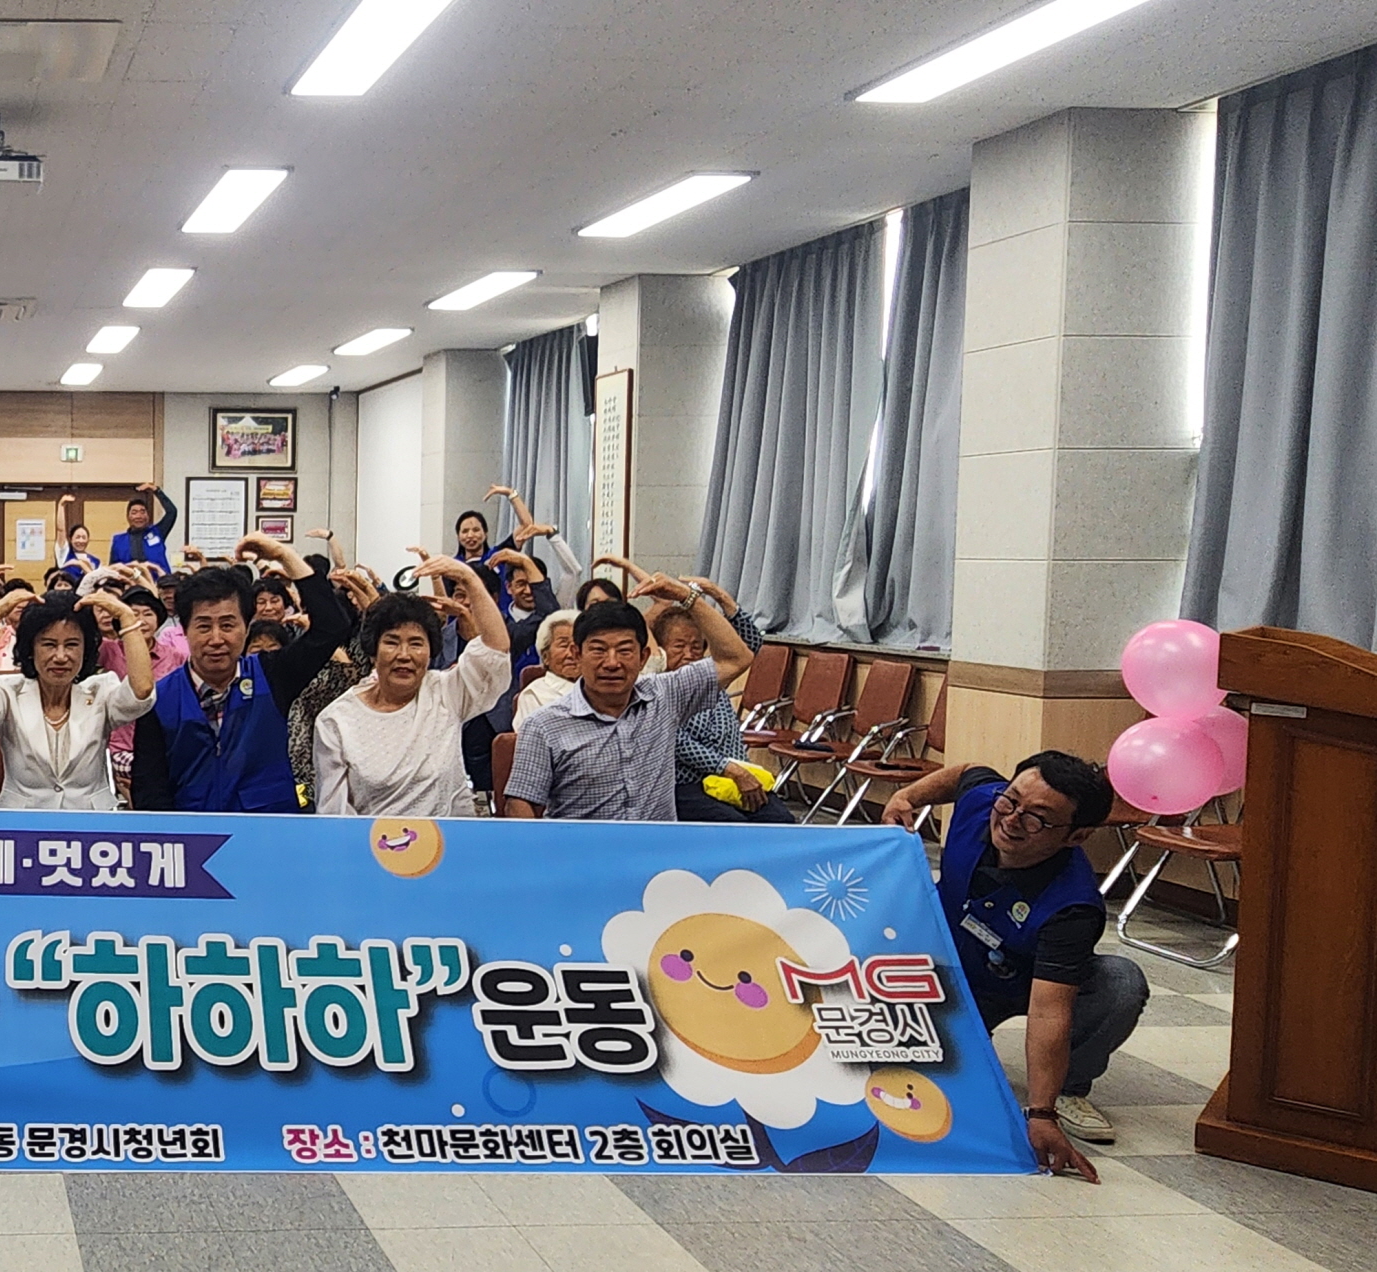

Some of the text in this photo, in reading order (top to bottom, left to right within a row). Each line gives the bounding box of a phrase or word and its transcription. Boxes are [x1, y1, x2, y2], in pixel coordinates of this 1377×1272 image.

[779, 957, 942, 1001] MG
[477, 967, 654, 1069] 운동
[816, 1006, 936, 1045] 문경시
[830, 1049, 941, 1060] MUNGYEONG CITY
[24, 1125, 222, 1160] 문경시청년회
[286, 1127, 354, 1161] 장소
[380, 1127, 582, 1162] 천마문화센터
[588, 1130, 646, 1163] 2층
[655, 1127, 756, 1163] 회의실
